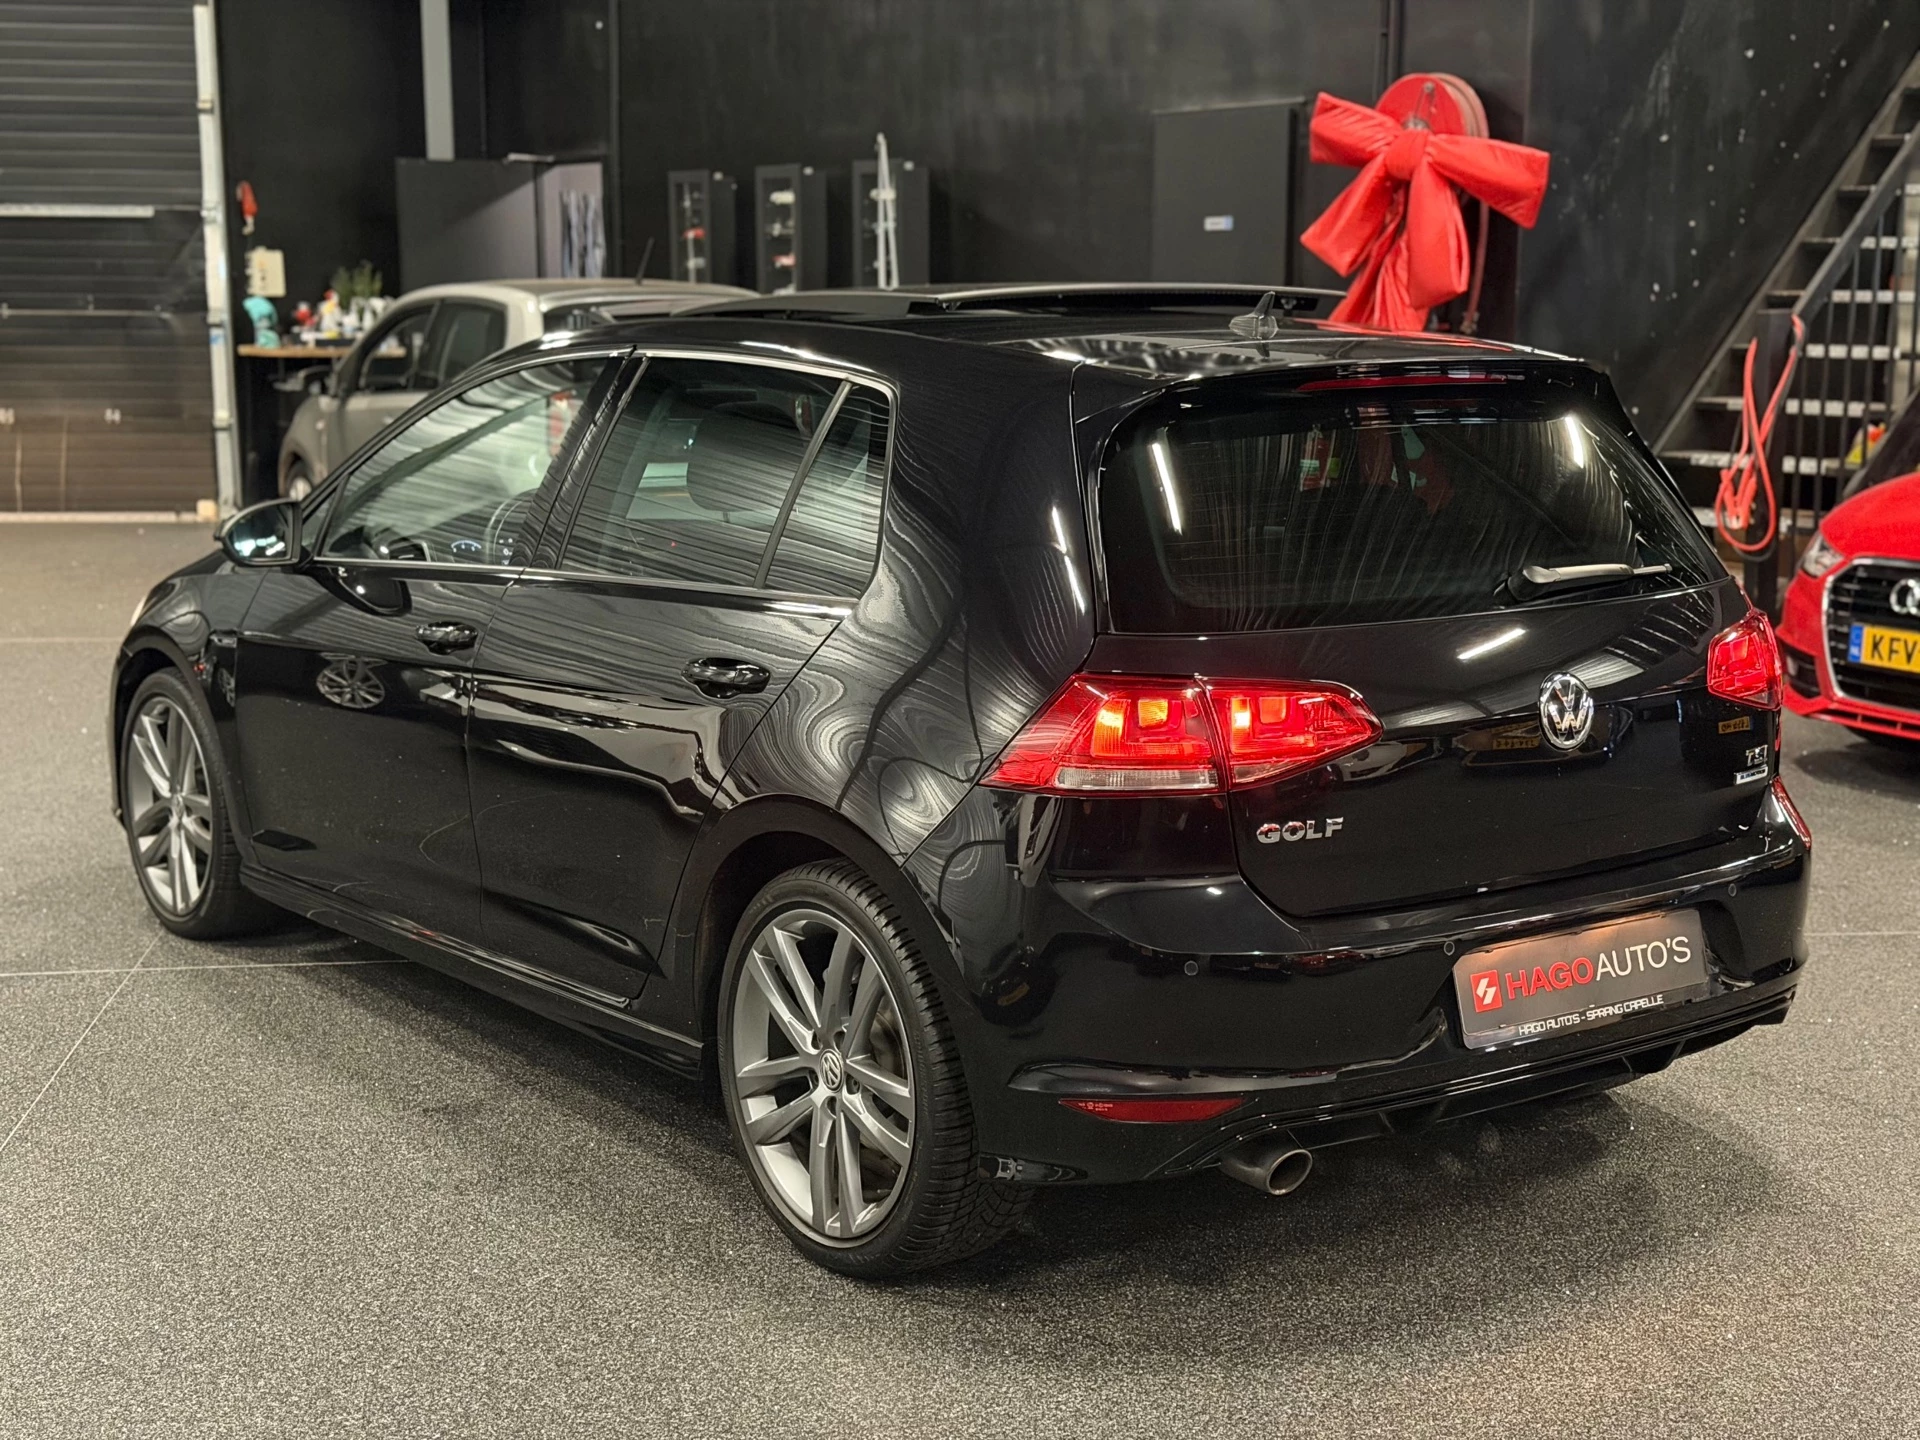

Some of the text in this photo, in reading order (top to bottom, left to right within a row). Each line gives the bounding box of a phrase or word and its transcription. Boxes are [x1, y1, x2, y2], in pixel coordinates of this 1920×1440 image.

[1871, 633, 1920, 665] KFV
[1256, 816, 1344, 844] GOLF
[1518, 1021, 1546, 1036] HAGO
[1546, 1013, 1580, 1031] AUTO'S
[1586, 1003, 1623, 1021] SPRANG
[1623, 994, 1664, 1012] CAPELLE
